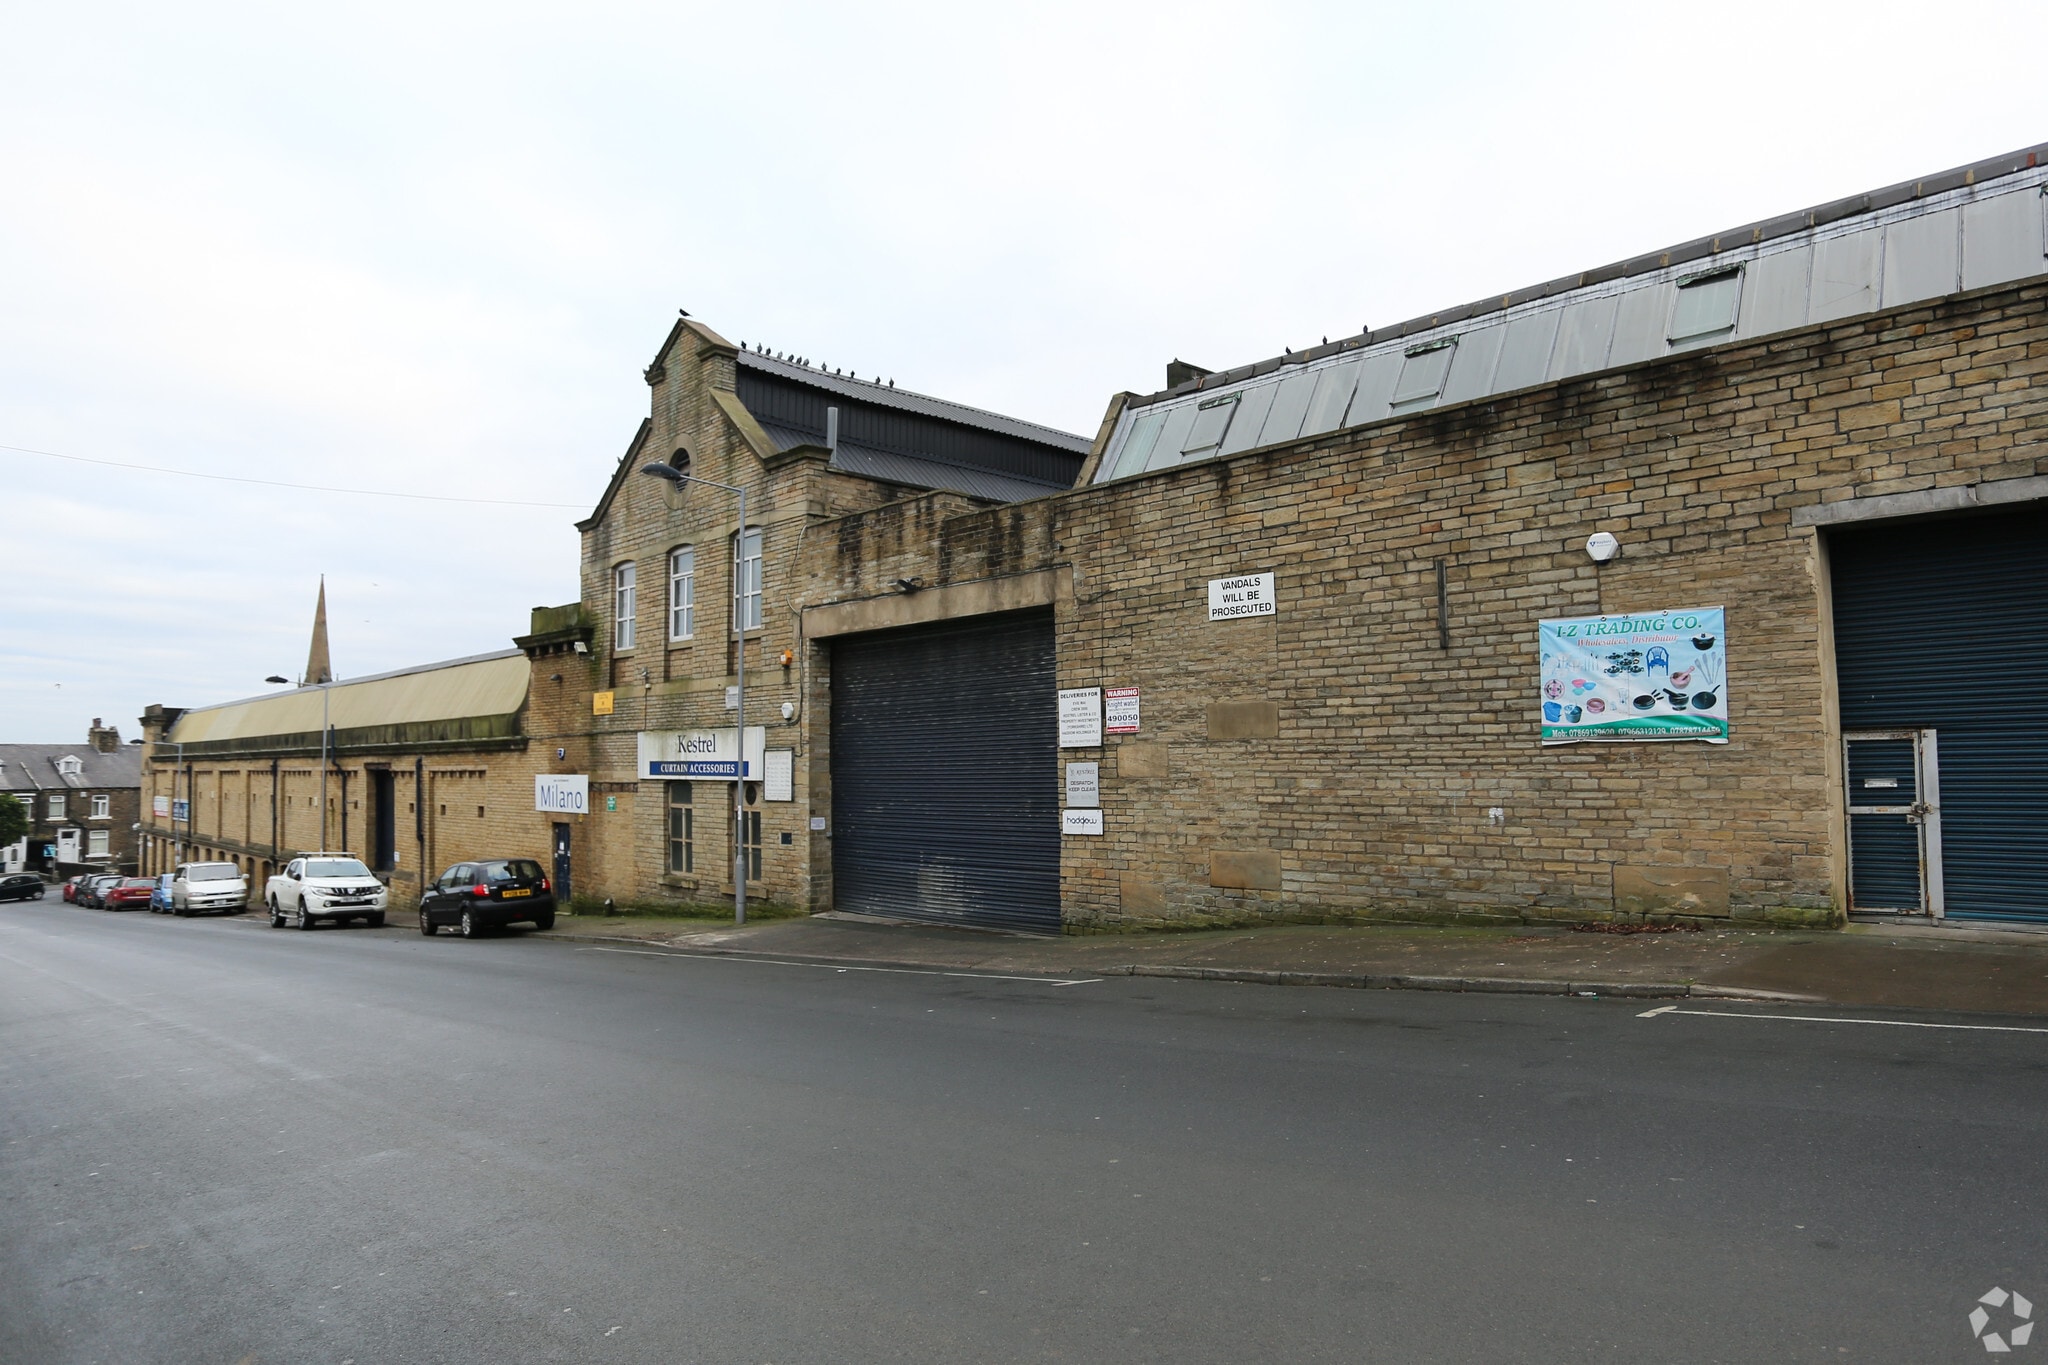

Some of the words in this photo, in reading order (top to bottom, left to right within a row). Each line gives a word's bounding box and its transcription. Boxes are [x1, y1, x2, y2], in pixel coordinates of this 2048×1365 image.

[1221, 577, 1261, 590] VANDALS
[1222, 592, 1244, 603] WILL
[1247, 590, 1260, 601] BE
[1212, 602, 1272, 617] PROSECUTED
[1556, 625, 1578, 638] I-Z
[1584, 618, 1665, 636] TRADING
[1671, 616, 1702, 630] CO.
[1631, 633, 1679, 645] Distributor
[1107, 689, 1138, 698] WARNING
[1107, 714, 1138, 722] 490050
[1552, 729, 1568, 738] Mob:
[677, 734, 717, 753] Kestrel
[660, 763, 688, 773] CURTAIN
[689, 763, 735, 774] ACCESSORIES
[540, 784, 583, 809] Milano
[1066, 815, 1097, 825] haddow
